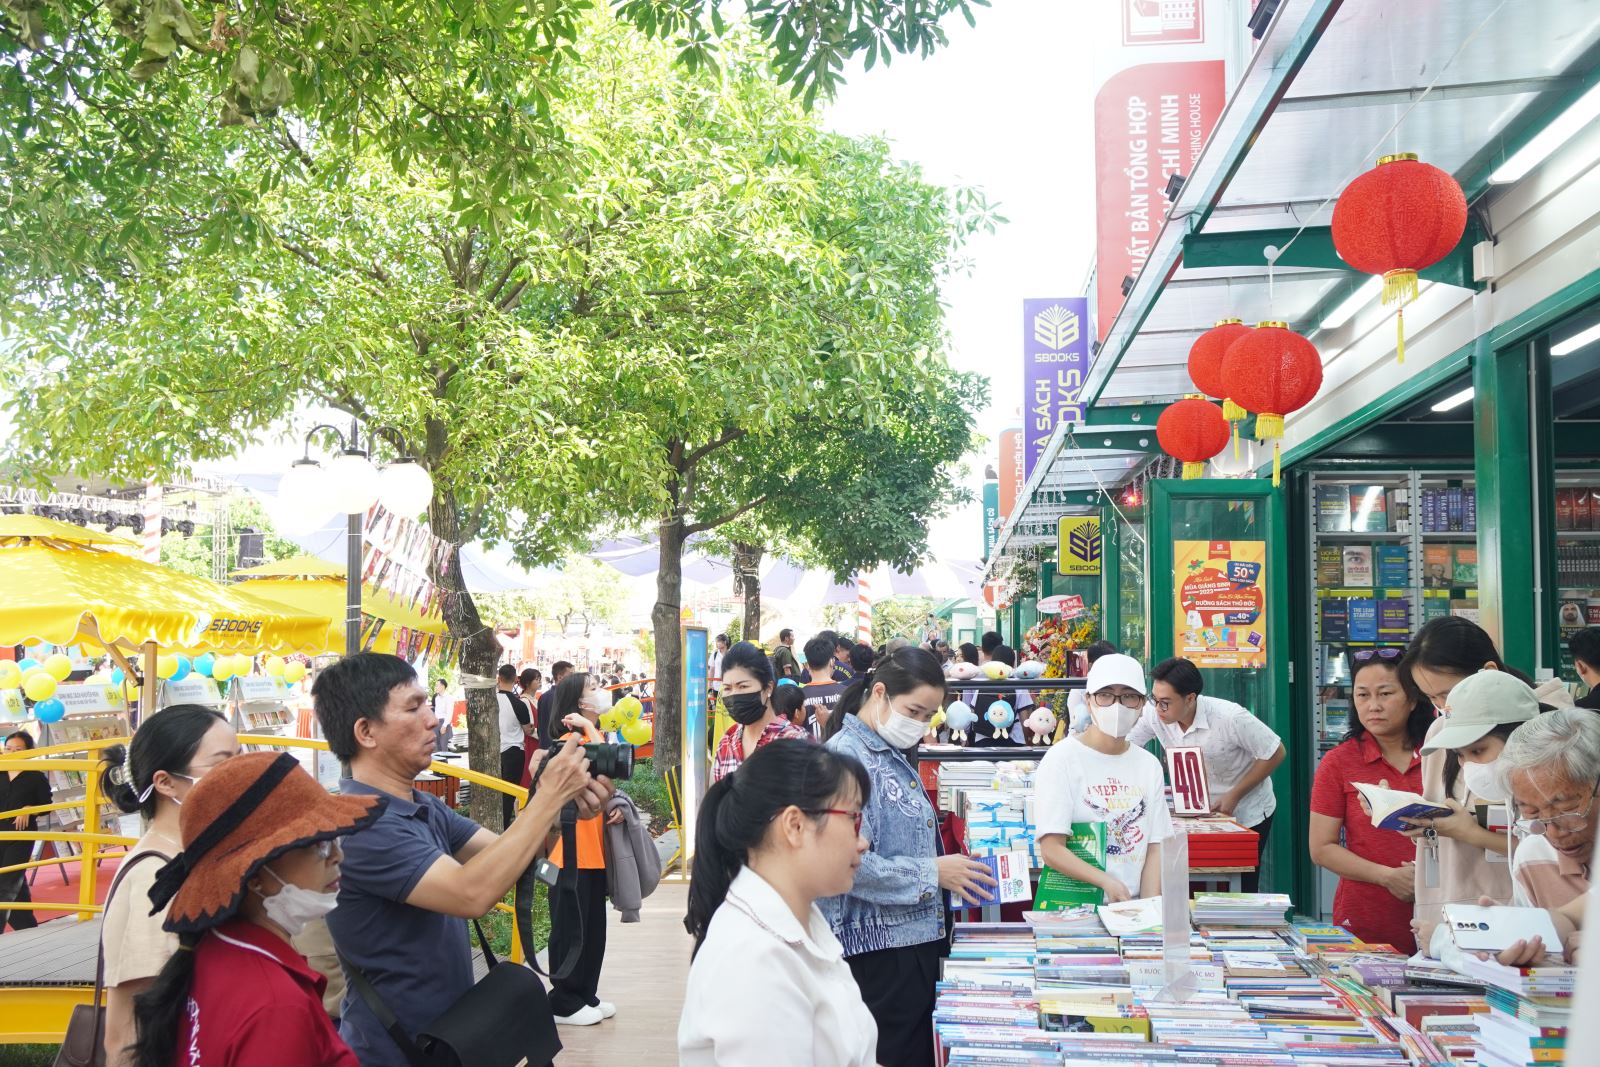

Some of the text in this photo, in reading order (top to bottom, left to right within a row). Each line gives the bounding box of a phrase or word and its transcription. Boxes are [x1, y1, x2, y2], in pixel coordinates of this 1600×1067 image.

[1127, 95, 1152, 135] HỢP
[1160, 95, 1180, 144] MINH
[1189, 93, 1201, 127] HOUSE
[1124, 139, 1149, 190] TỔNG
[1158, 148, 1180, 180] CHÍ
[1126, 194, 1149, 231] BẢN
[1034, 352, 1080, 362] SBOOKS
[1032, 379, 1052, 431] SÁCH
[210, 618, 263, 633] SBOOKS
[804, 696, 824, 706] MINH
[1088, 785, 1144, 796] AMERICAN
[1174, 752, 1205, 810] 40
